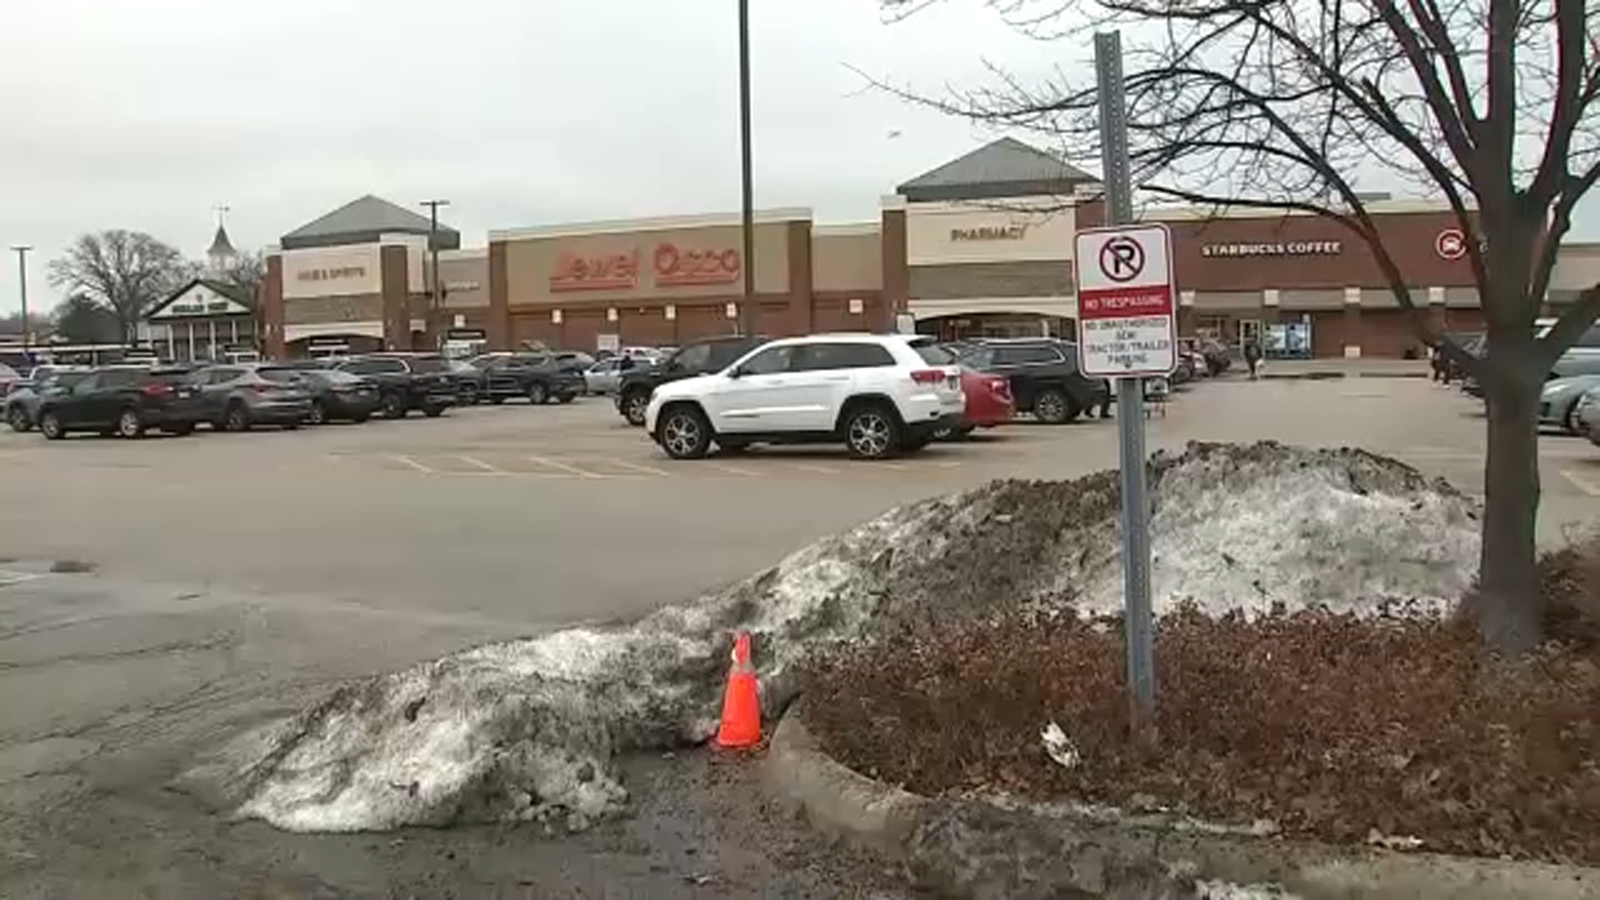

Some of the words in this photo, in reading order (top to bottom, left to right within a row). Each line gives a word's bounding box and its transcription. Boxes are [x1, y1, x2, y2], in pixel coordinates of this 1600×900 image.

[951, 226, 1026, 241] PHARMACY
[1202, 243, 1284, 256] STARBUCKS
[1287, 241, 1341, 254] COFFEE
[1084, 298, 1099, 310] NO
[1100, 294, 1165, 309] TRESPASSING
[1085, 321, 1098, 331] NO
[1100, 318, 1168, 330] UNAUTHORIZED
[1107, 353, 1149, 365] PARKING
